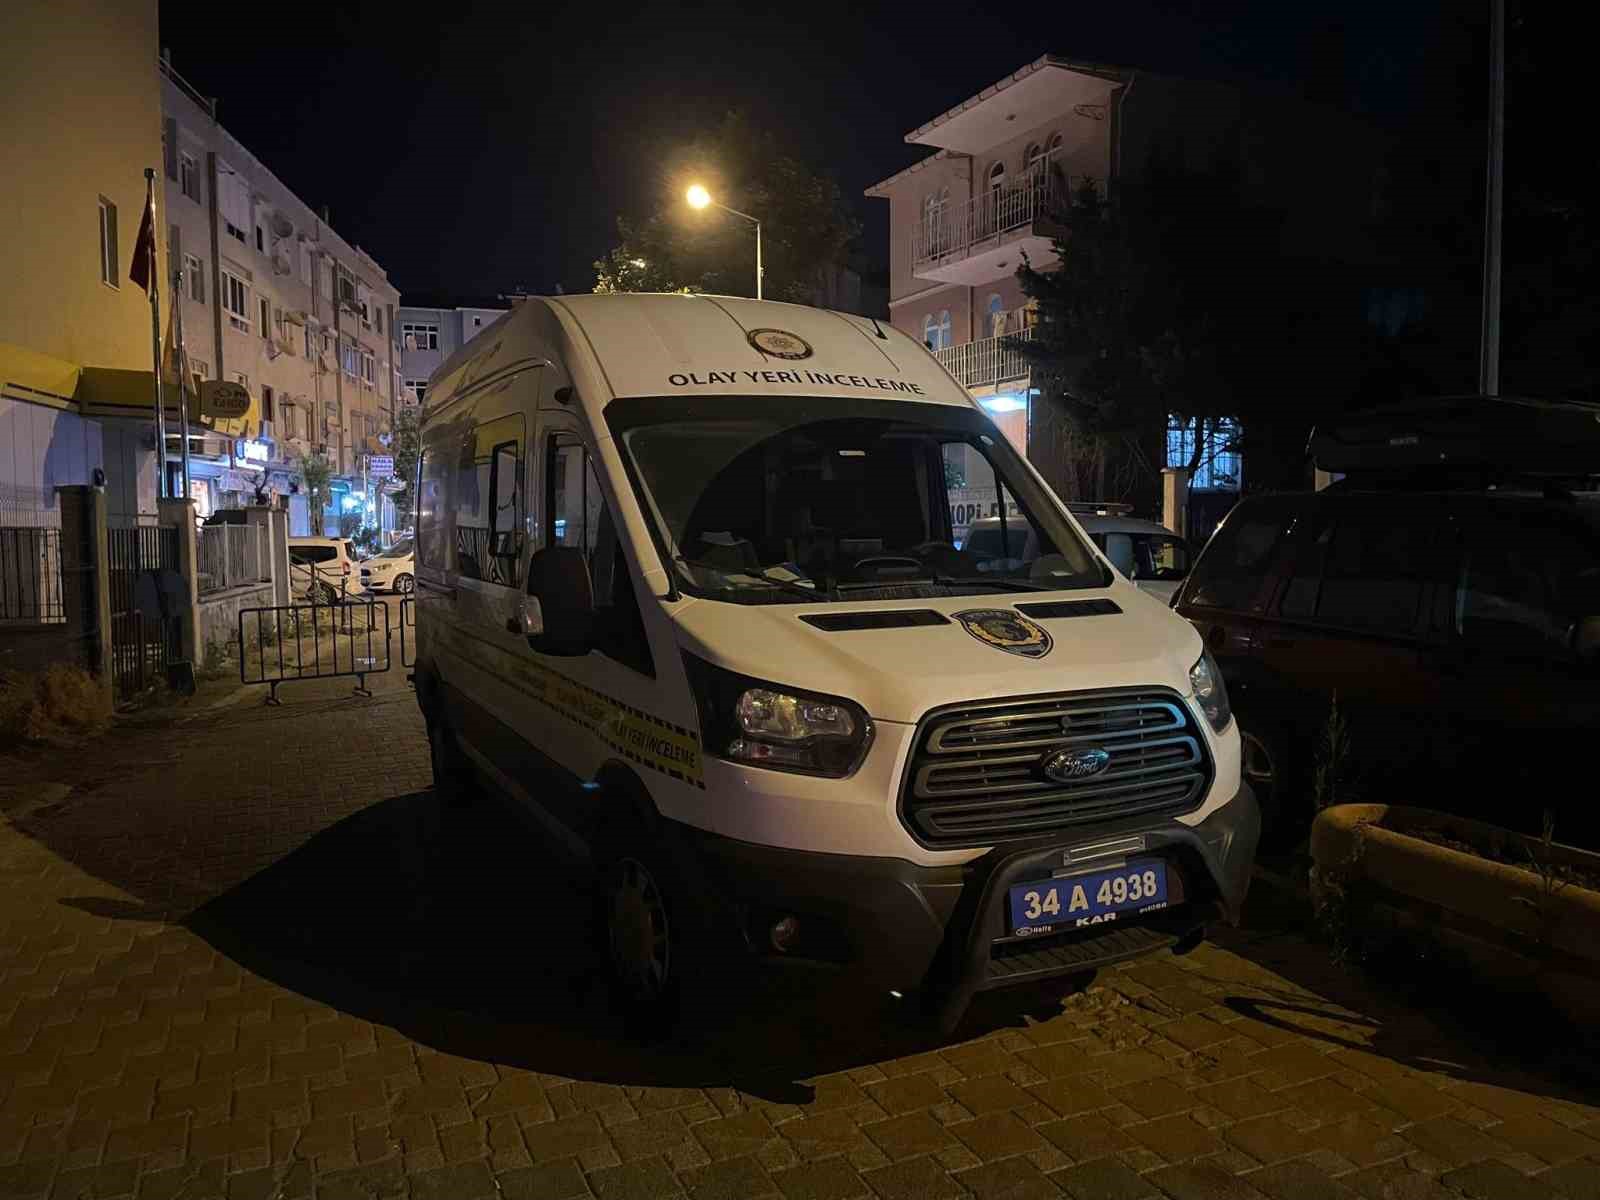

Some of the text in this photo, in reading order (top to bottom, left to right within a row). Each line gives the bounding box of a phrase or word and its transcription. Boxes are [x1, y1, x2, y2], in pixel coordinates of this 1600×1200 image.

[668, 368, 926, 395] OLAY YERİ İNCELEME
[1024, 870, 1157, 919] 34 A 4938
[1076, 912, 1116, 927] KAR
